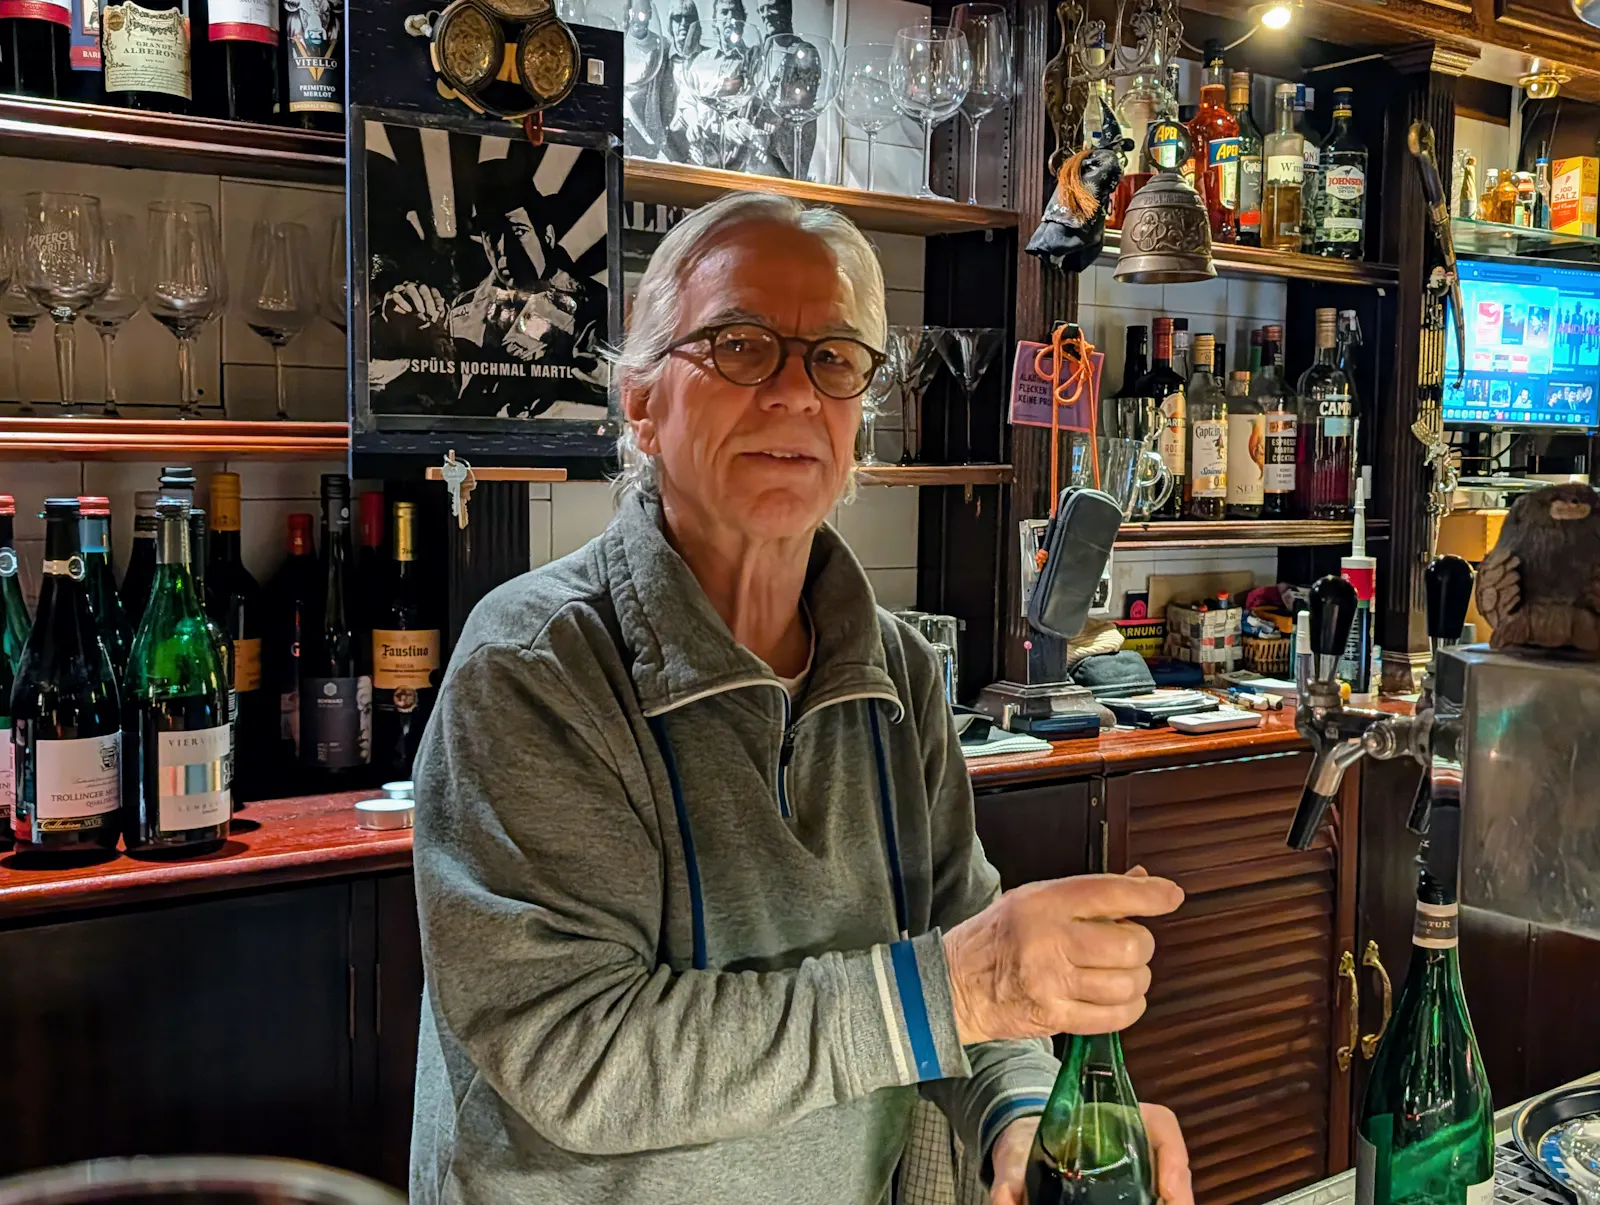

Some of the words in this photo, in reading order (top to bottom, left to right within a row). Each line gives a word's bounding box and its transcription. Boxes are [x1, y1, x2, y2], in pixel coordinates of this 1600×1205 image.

[136, 41, 173, 51] GRANDE
[123, 47, 184, 61] ALBERONE
[295, 58, 338, 68] VITELLO
[299, 84, 336, 92] PRIMITIVO
[303, 90, 332, 98] MERLOT
[1554, 191, 1577, 202] SALZ
[411, 356, 456, 374] SPÜLS
[460, 361, 527, 377] NOCHMAL
[1019, 383, 1047, 395] FLECKEN
[1018, 394, 1038, 405] KEINE
[381, 644, 429, 659] Faustino
[51, 790, 104, 802] TROLLINGER
[41, 819, 81, 830] Collection
